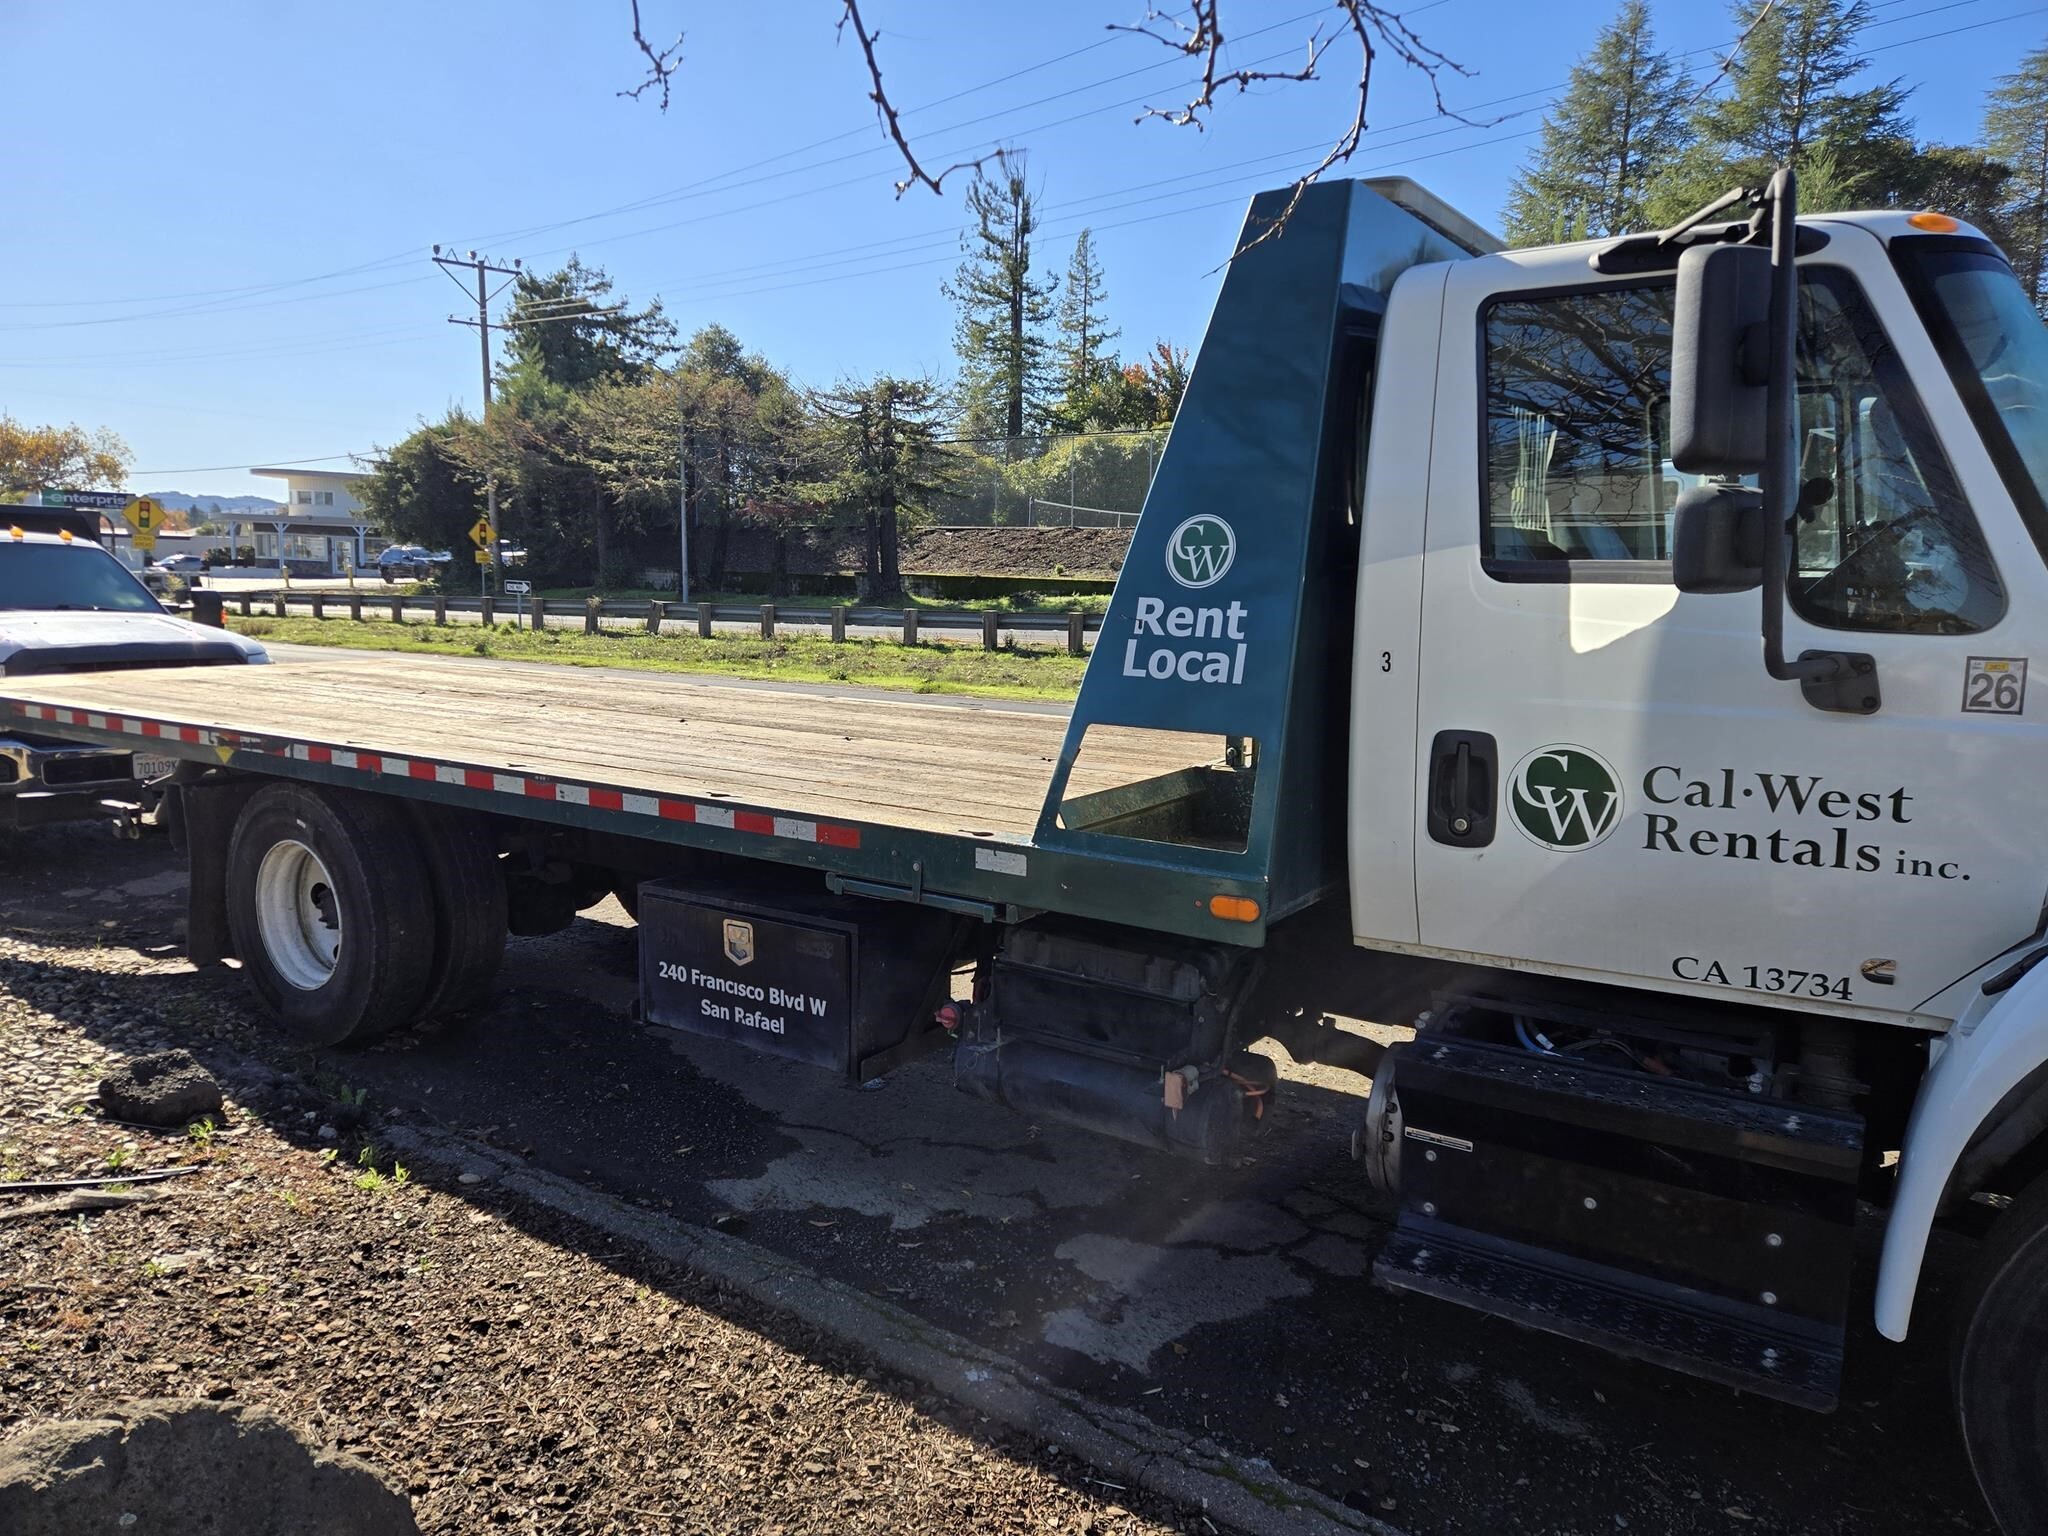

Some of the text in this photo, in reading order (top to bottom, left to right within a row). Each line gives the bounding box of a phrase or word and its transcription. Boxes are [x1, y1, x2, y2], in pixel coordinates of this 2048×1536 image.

[51, 492, 126, 506] enterpris
[1133, 596, 1248, 640] Rent
[1122, 638, 1248, 685] Local
[1381, 651, 1391, 673] 3
[1968, 673, 2018, 709] 26
[1641, 813, 1971, 881] Rentals inc.
[658, 961, 827, 1017] 240 Francisco Blvd W
[1671, 956, 1854, 1001] CA 13734
[700, 998, 785, 1035] San Rafael
